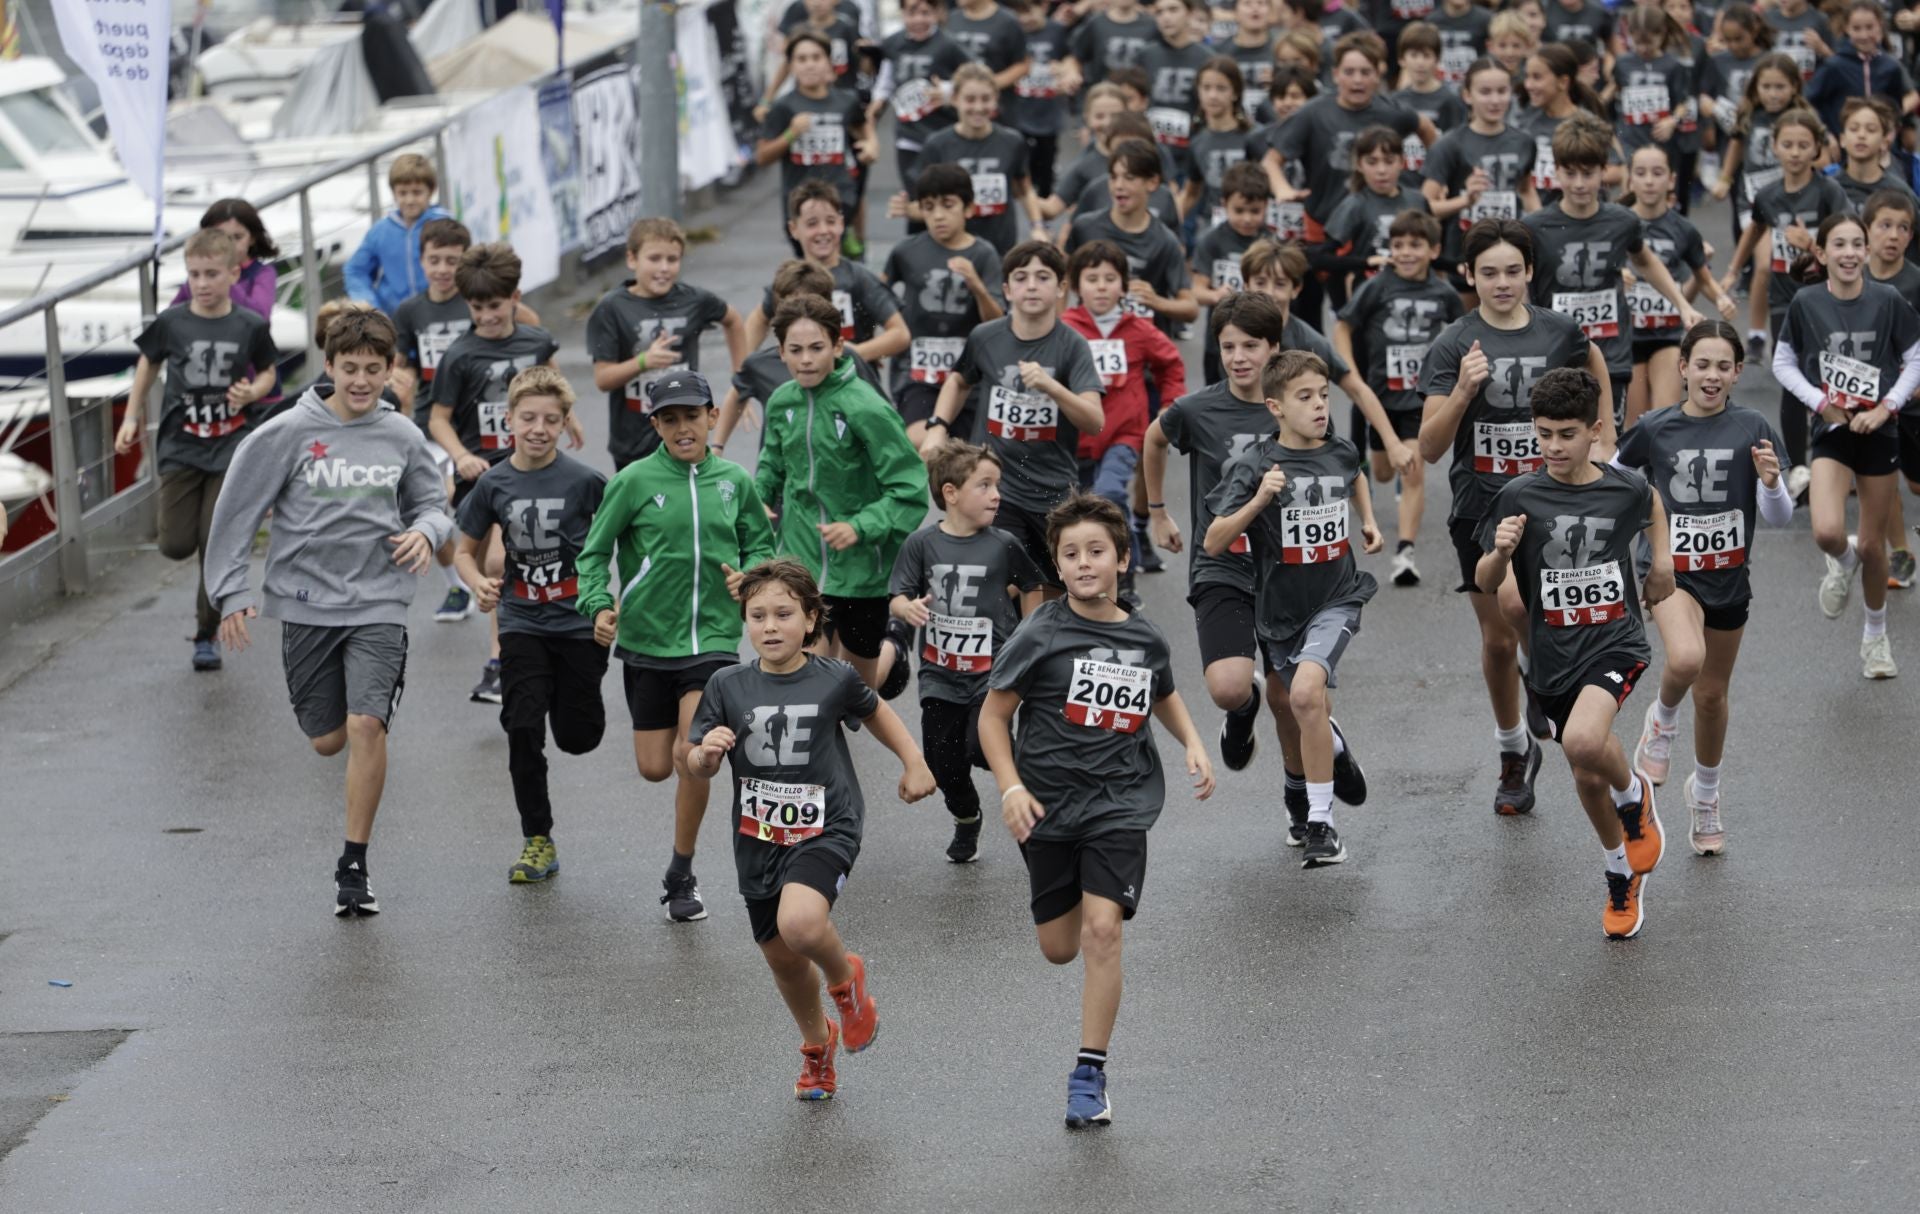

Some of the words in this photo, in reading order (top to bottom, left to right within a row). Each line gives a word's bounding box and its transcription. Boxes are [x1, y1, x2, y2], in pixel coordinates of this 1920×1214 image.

[1564, 303, 1613, 325] 632
[995, 402, 1052, 426] 1823
[1288, 516, 1346, 545] 1981
[1674, 526, 1738, 553] 2061
[517, 561, 563, 587] 747
[1547, 580, 1621, 608] 1963
[928, 627, 987, 654] 1777
[1074, 678, 1147, 712] 2064
[746, 795, 820, 826] 1709
